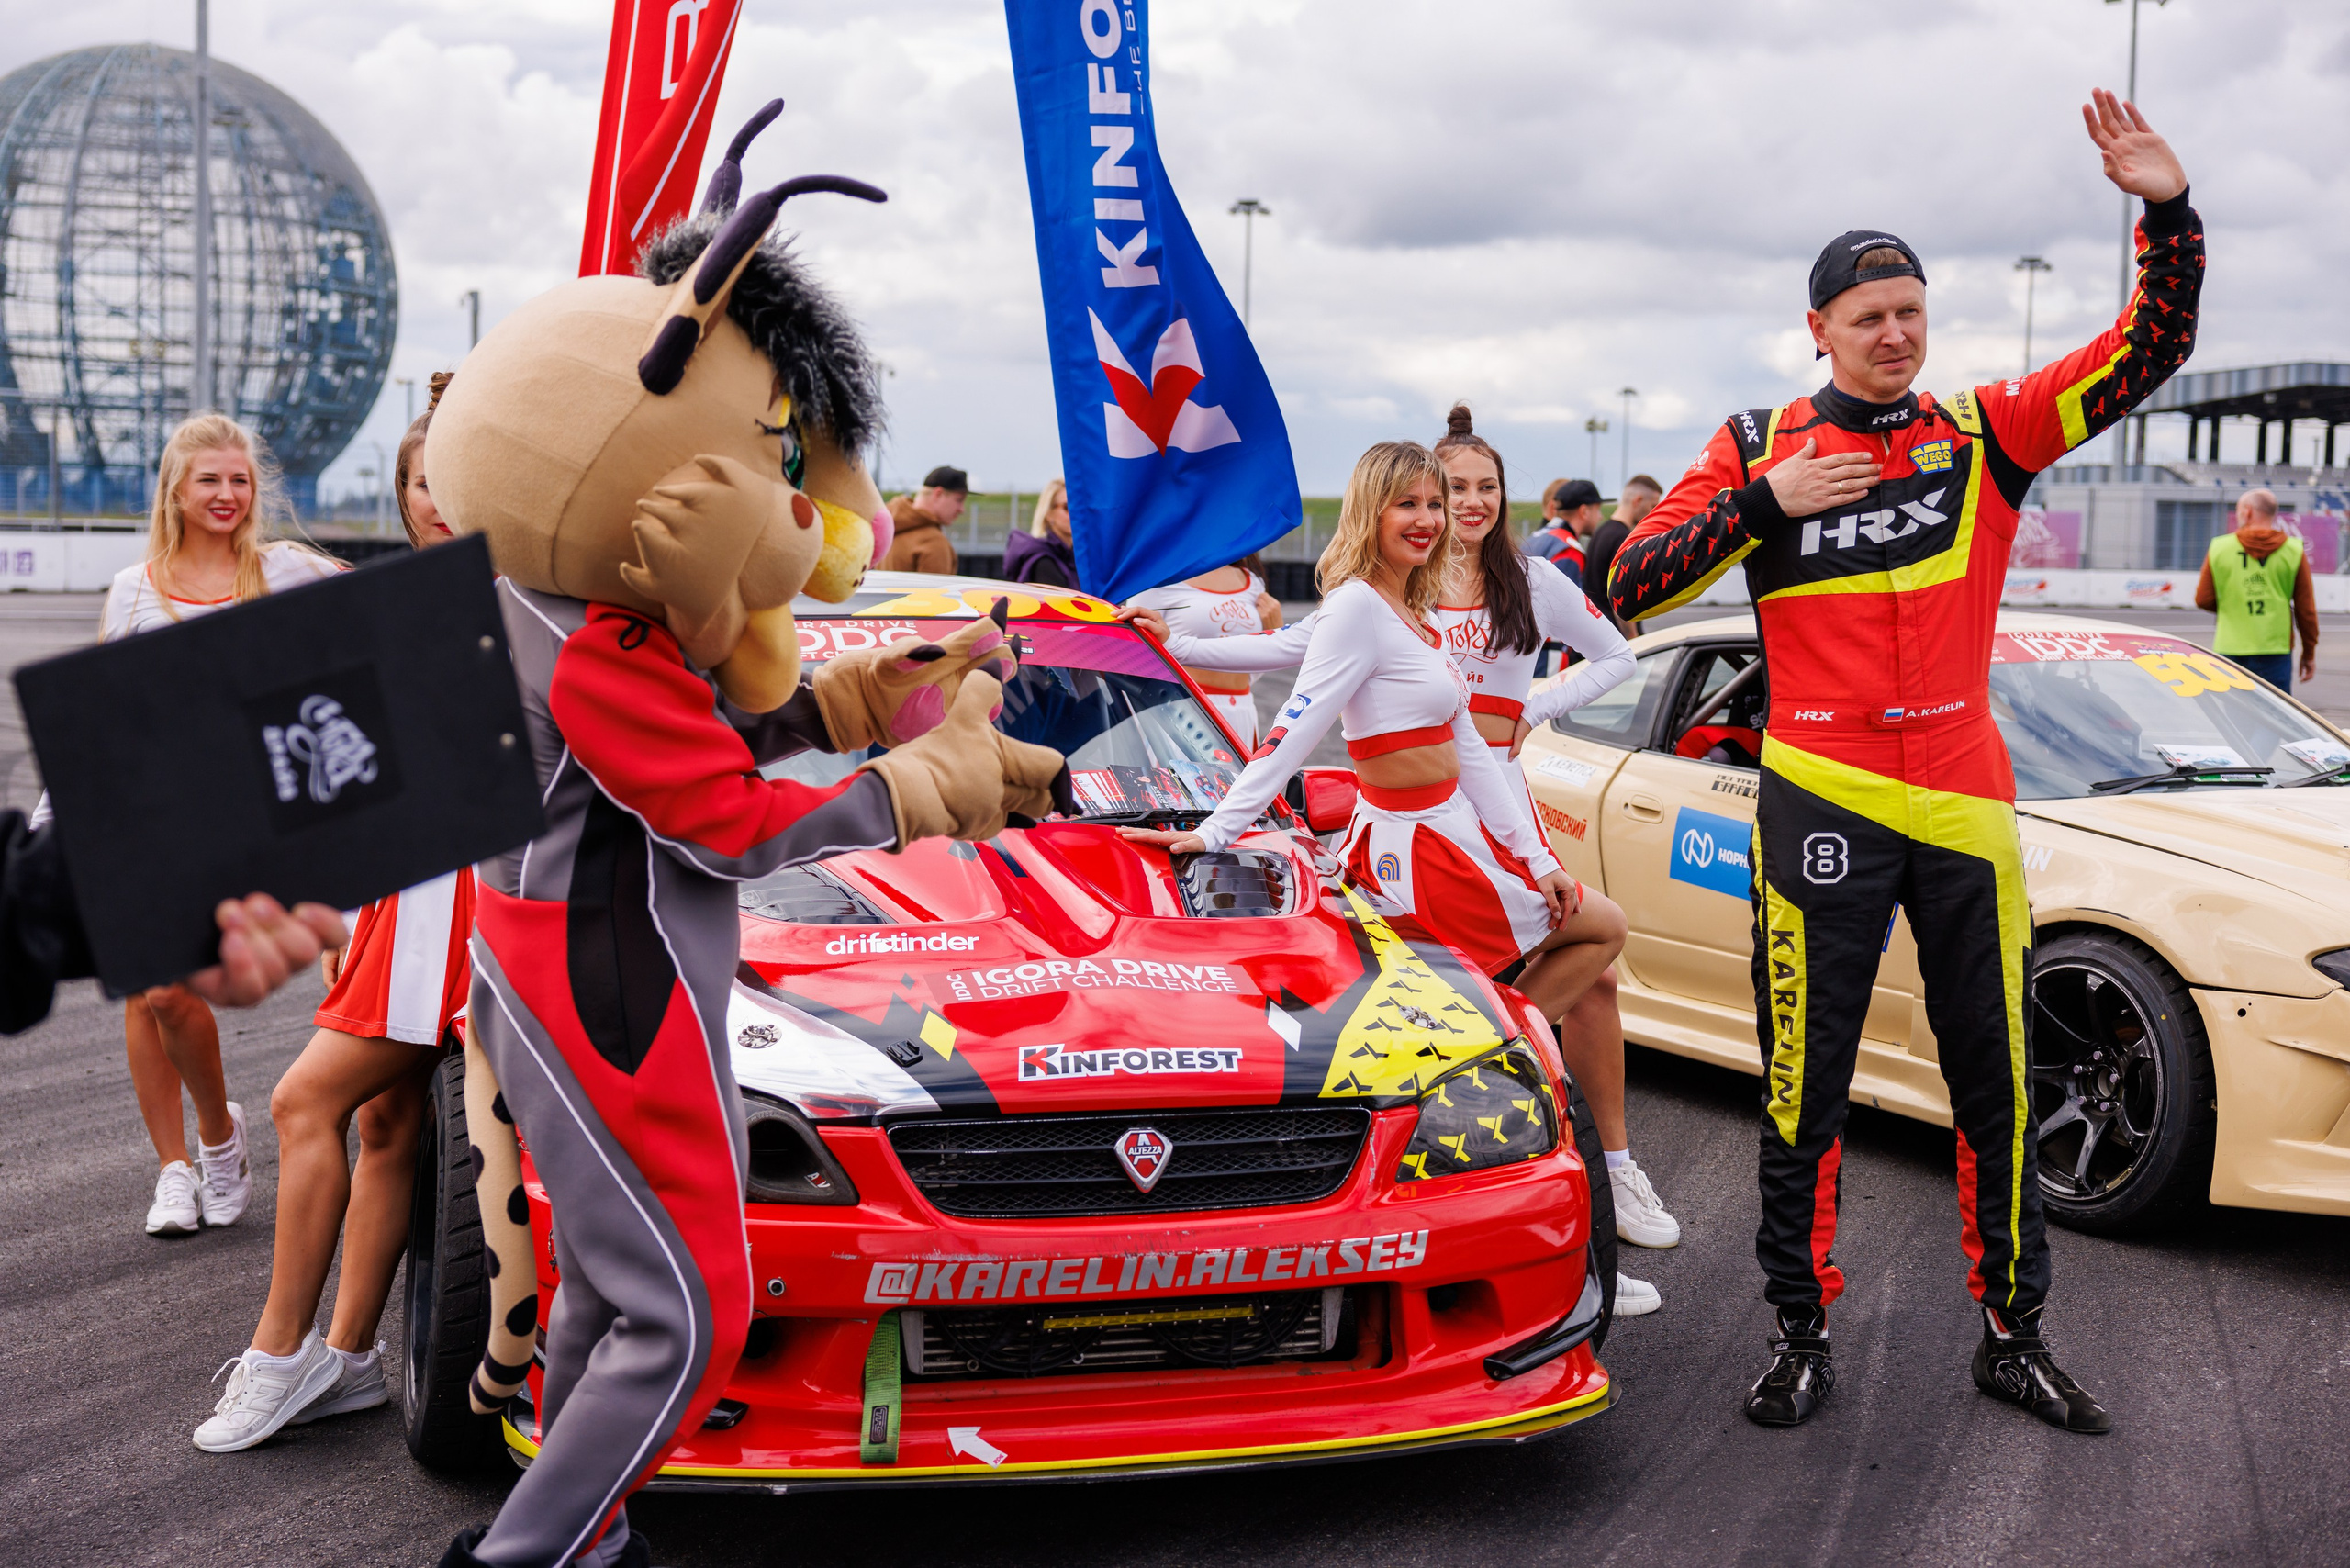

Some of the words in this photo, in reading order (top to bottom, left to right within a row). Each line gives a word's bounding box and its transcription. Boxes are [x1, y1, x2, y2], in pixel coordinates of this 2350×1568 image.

[1739, 410, 1761, 443] HRX
[1872, 408, 1909, 425] HRX
[1913, 450, 1952, 465] WEGO
[1800, 487, 1949, 556] HRX
[2247, 600, 2265, 615] 12
[845, 620, 917, 628] DRIVE
[2013, 637, 2125, 656] IDDC
[2132, 652, 2256, 698] 500
[1793, 711, 1835, 722] HRX
[1803, 832, 1848, 884] 8
[946, 973, 973, 1002] IDDC
[973, 958, 1107, 988] IGORA
[1111, 958, 1232, 982] DRIVE
[979, 977, 1064, 1000] DRIFT
[1071, 972, 1242, 994] CHALLENGE
[1770, 928, 1796, 1104] KARELIN
[1023, 1046, 1239, 1078] KINFOREST
[1127, 1145, 1164, 1156] ALTEZZA
[864, 1228, 1430, 1305] @KARELIN.ALEKSEY
